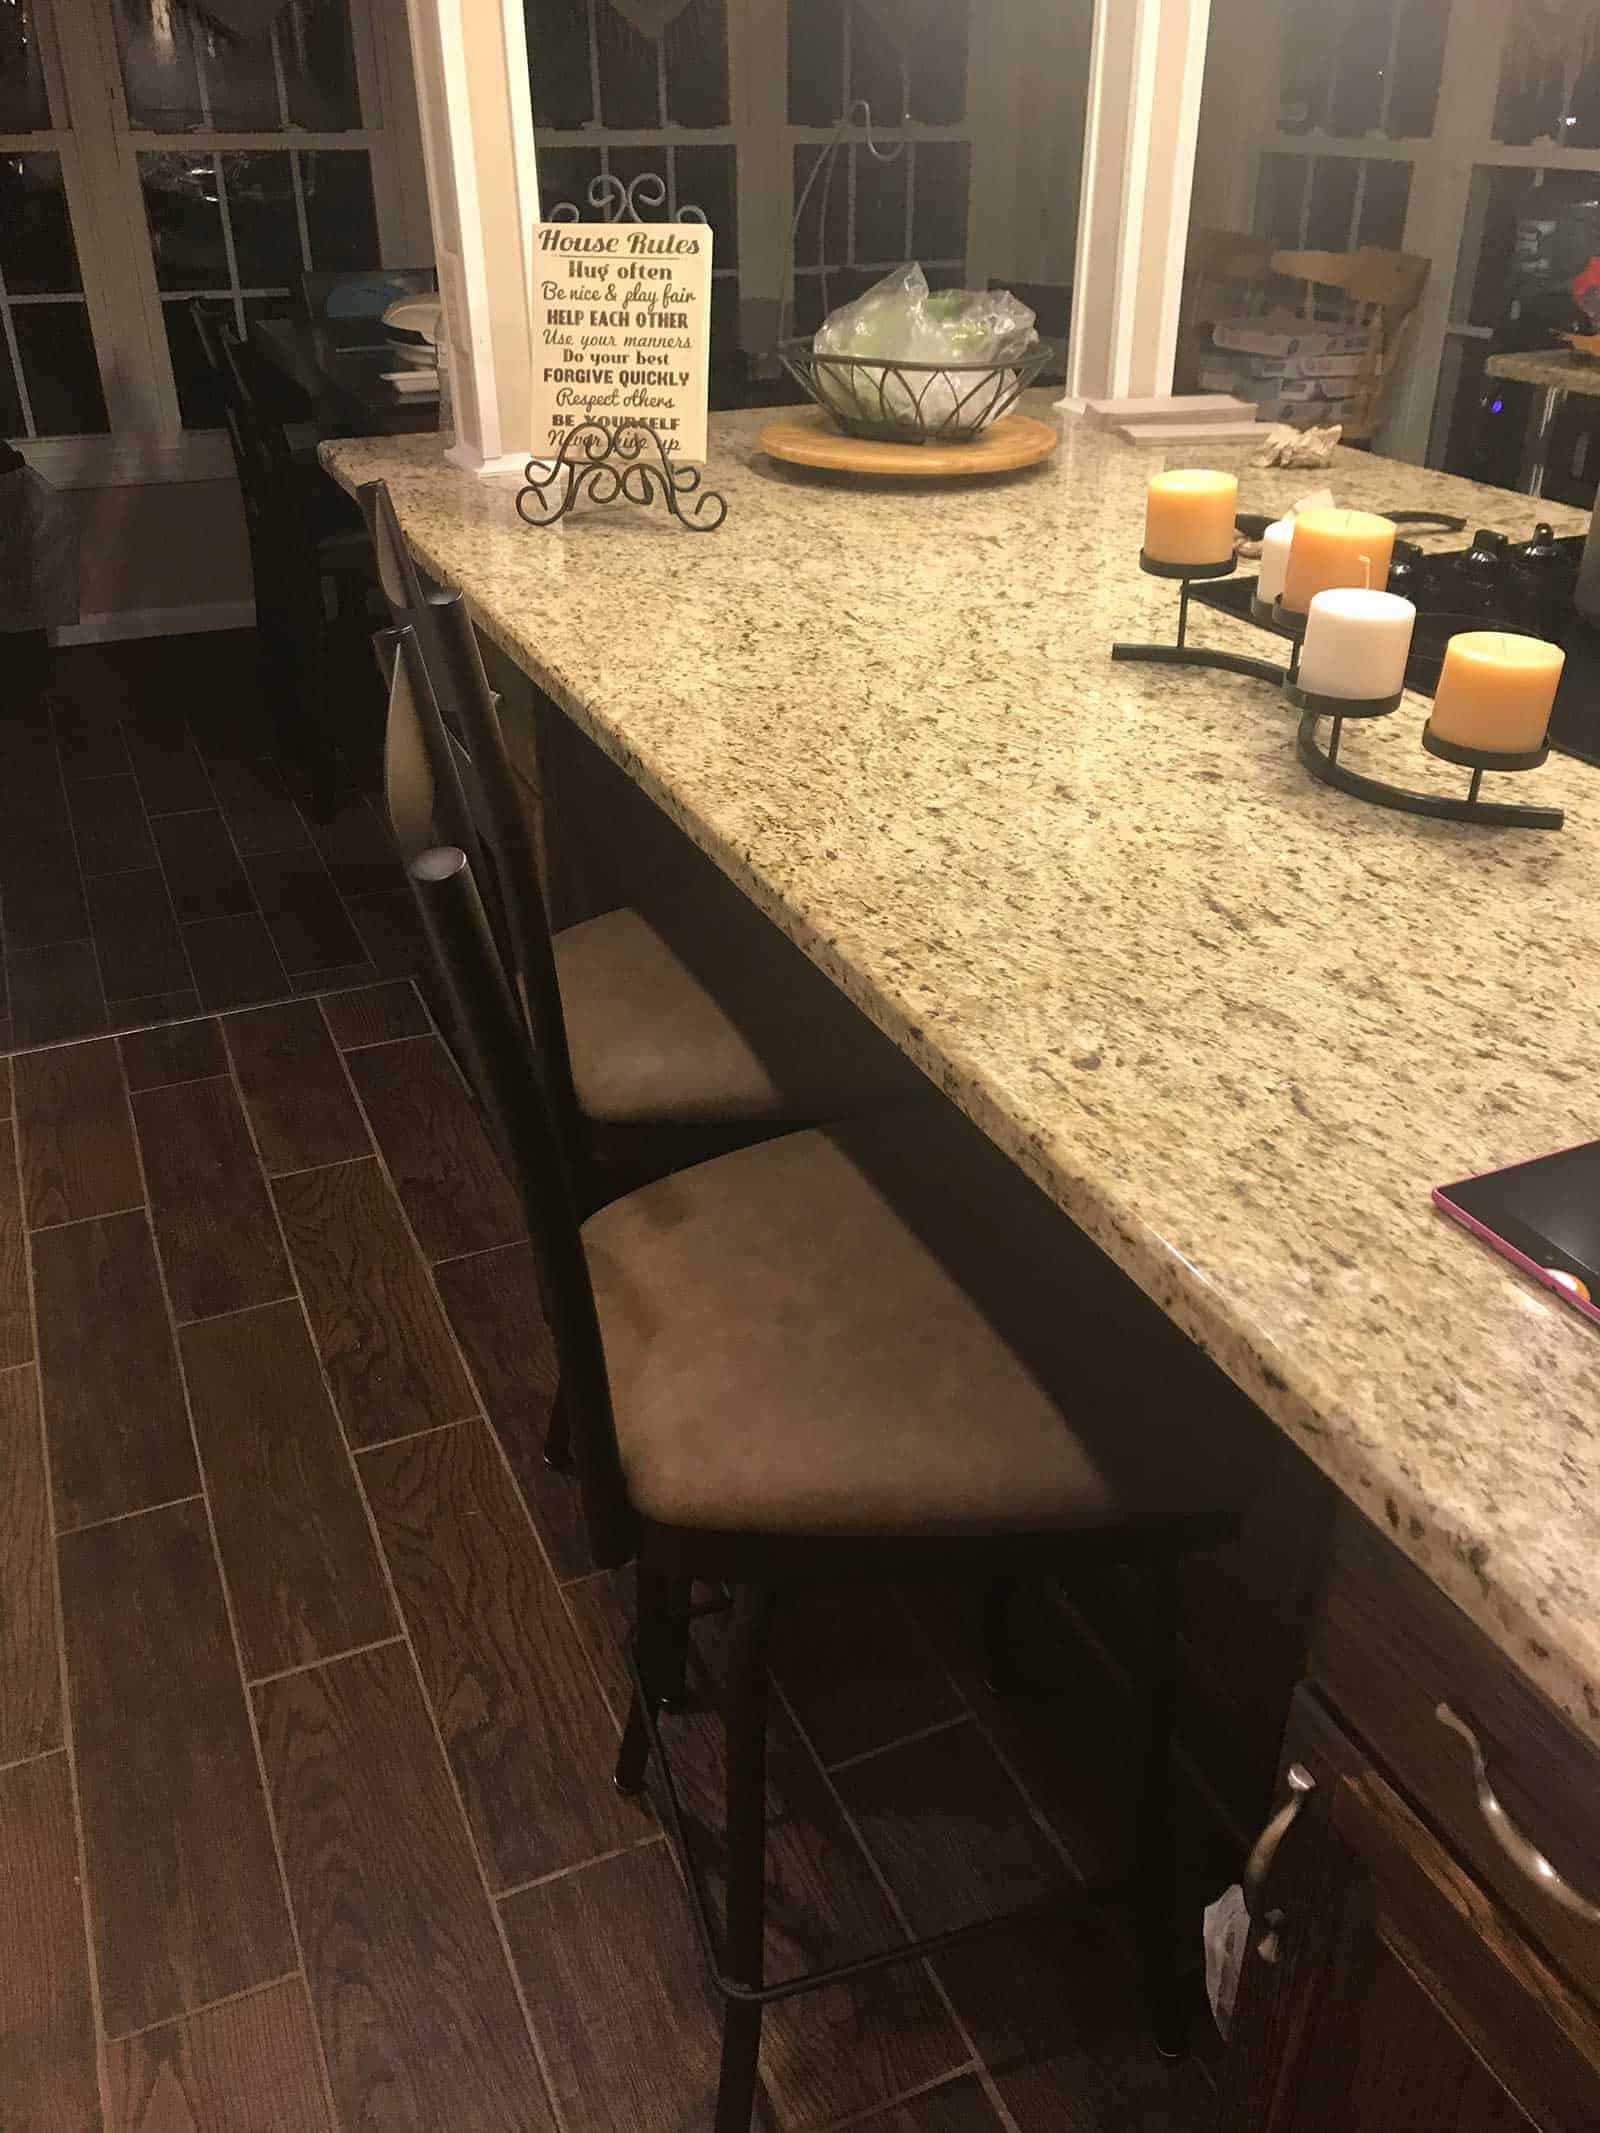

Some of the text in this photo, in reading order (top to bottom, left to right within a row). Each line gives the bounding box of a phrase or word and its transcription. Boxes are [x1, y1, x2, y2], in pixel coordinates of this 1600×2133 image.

[539, 229, 700, 255] House Rules
[568, 260, 672, 281] Hug often
[542, 281, 696, 311] Be nice & play fair
[547, 309, 688, 329] HELP EACH OTHER
[543, 330, 692, 349] Use your manners
[563, 349, 669, 366] Do your best
[544, 368, 689, 386] FORGIVE QUICKLY
[556, 388, 674, 412] Respect others
[552, 414, 575, 426] BE
[548, 430, 602, 448] Nver
[611, 431, 648, 453] ive
